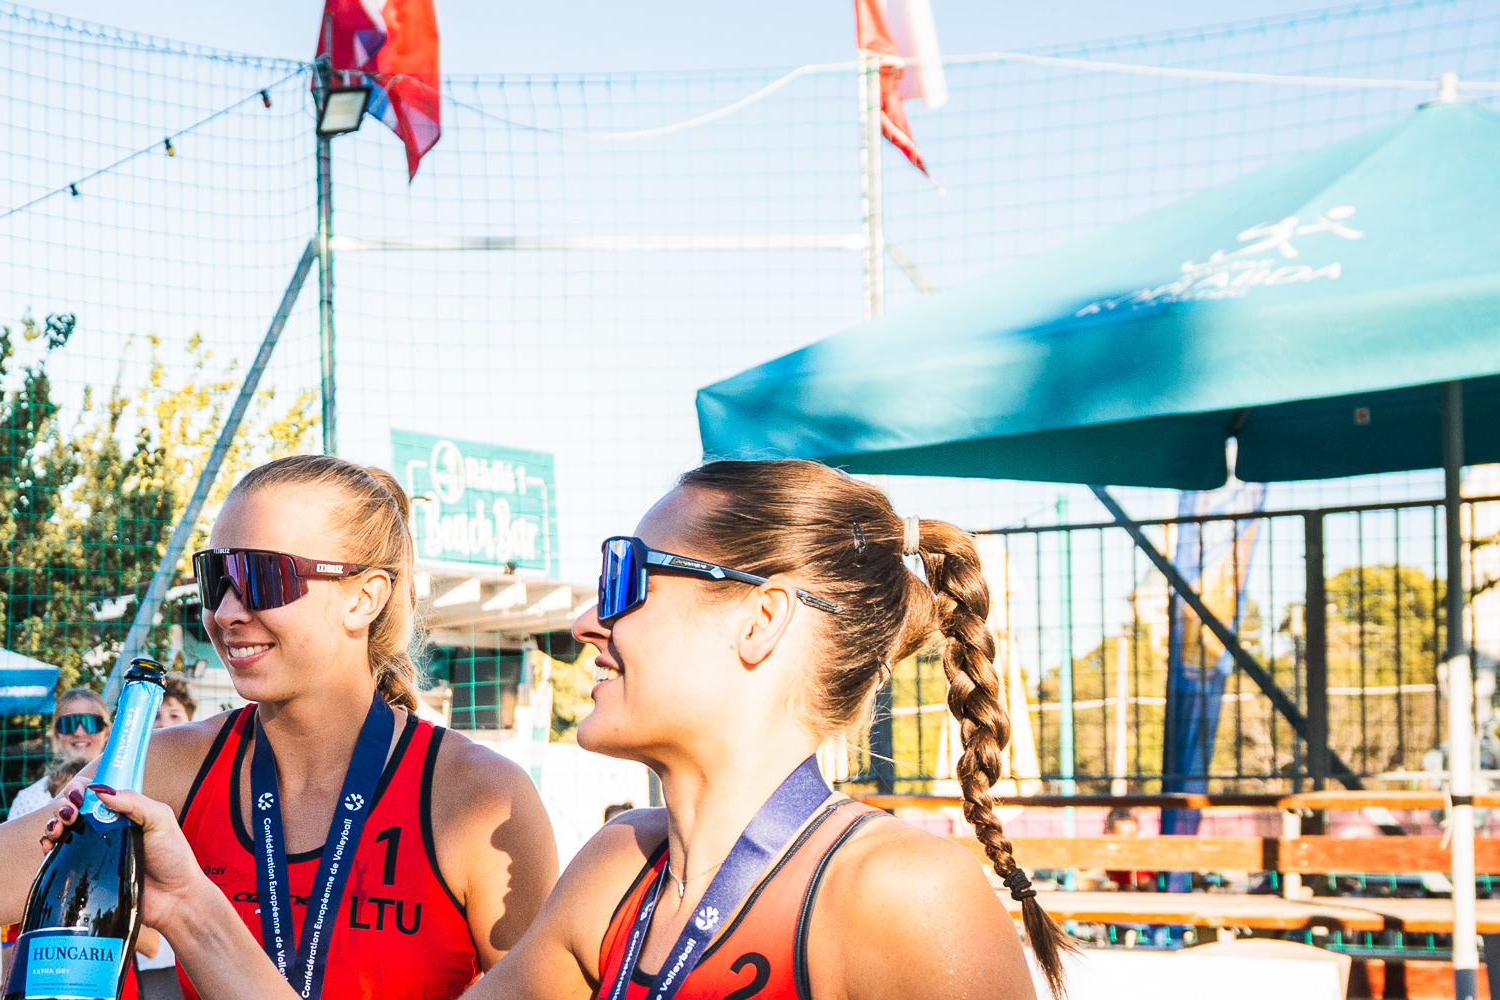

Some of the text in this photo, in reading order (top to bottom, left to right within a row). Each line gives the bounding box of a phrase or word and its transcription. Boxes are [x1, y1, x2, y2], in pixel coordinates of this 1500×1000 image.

[211, 867, 226, 875] CEV
[375, 826, 402, 886] 1
[263, 817, 289, 982] Confédération Européenne de Volley
[301, 818, 353, 999] Confédération Européenne de Volleyball
[348, 896, 422, 936] LTU
[33, 946, 114, 962] HUNGARIA
[659, 937, 697, 991] Volleyball
